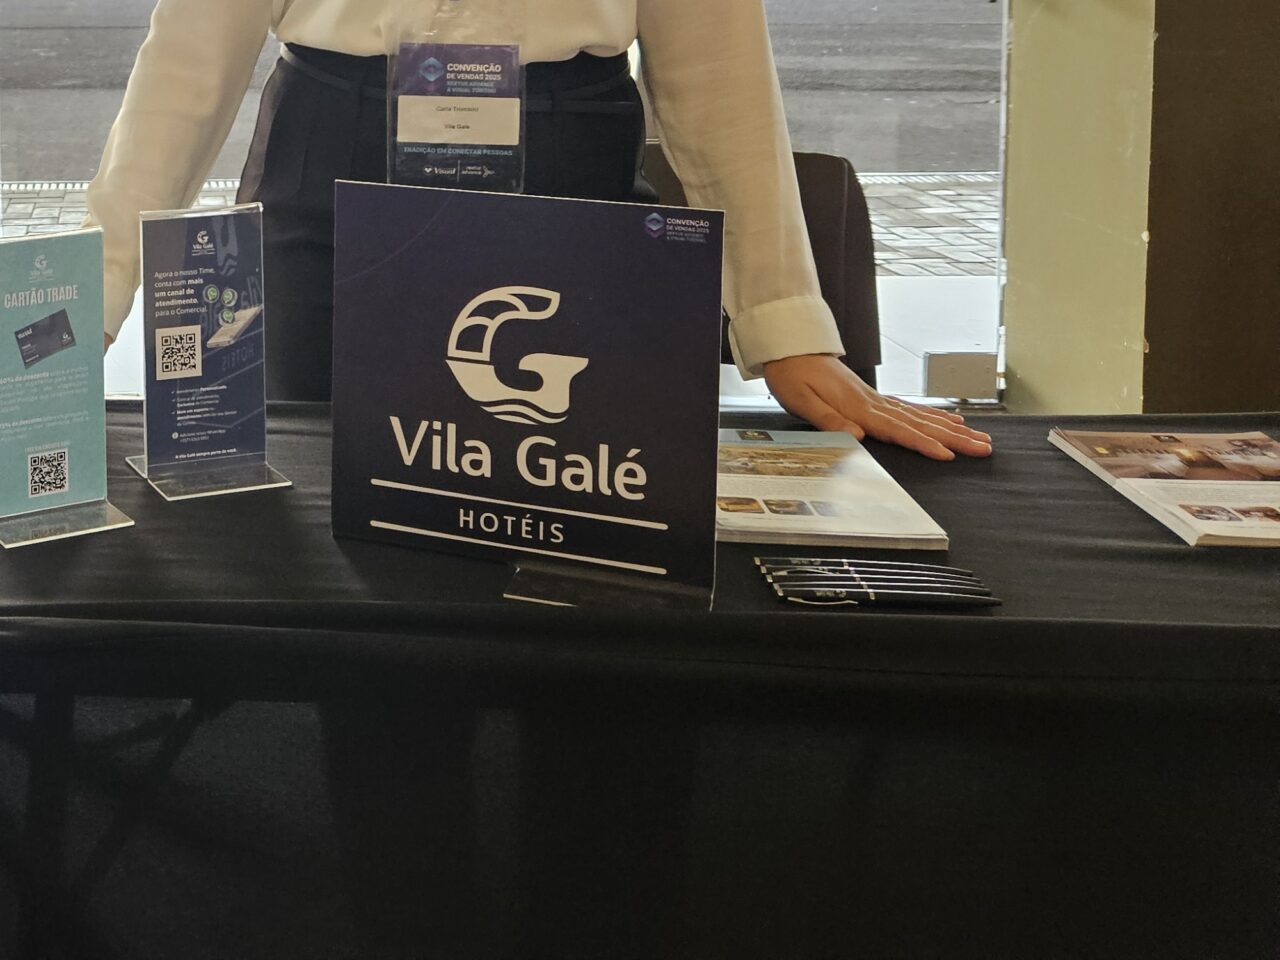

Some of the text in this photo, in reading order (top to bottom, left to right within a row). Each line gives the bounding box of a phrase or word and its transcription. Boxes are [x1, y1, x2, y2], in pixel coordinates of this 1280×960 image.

[447, 62, 502, 74] CONVENÇÃO
[457, 73, 484, 81] VENDAS
[666, 217, 710, 228] CONVENÇÃO
[155, 270, 173, 279] Agora
[155, 280, 172, 288] conta
[4, 284, 79, 309] CARTÃO TRADE
[167, 288, 185, 297] canal
[186, 287, 194, 295] de
[155, 309, 170, 318] para
[389, 415, 648, 501] Vila Galé
[459, 507, 565, 544] HOTÉIS
